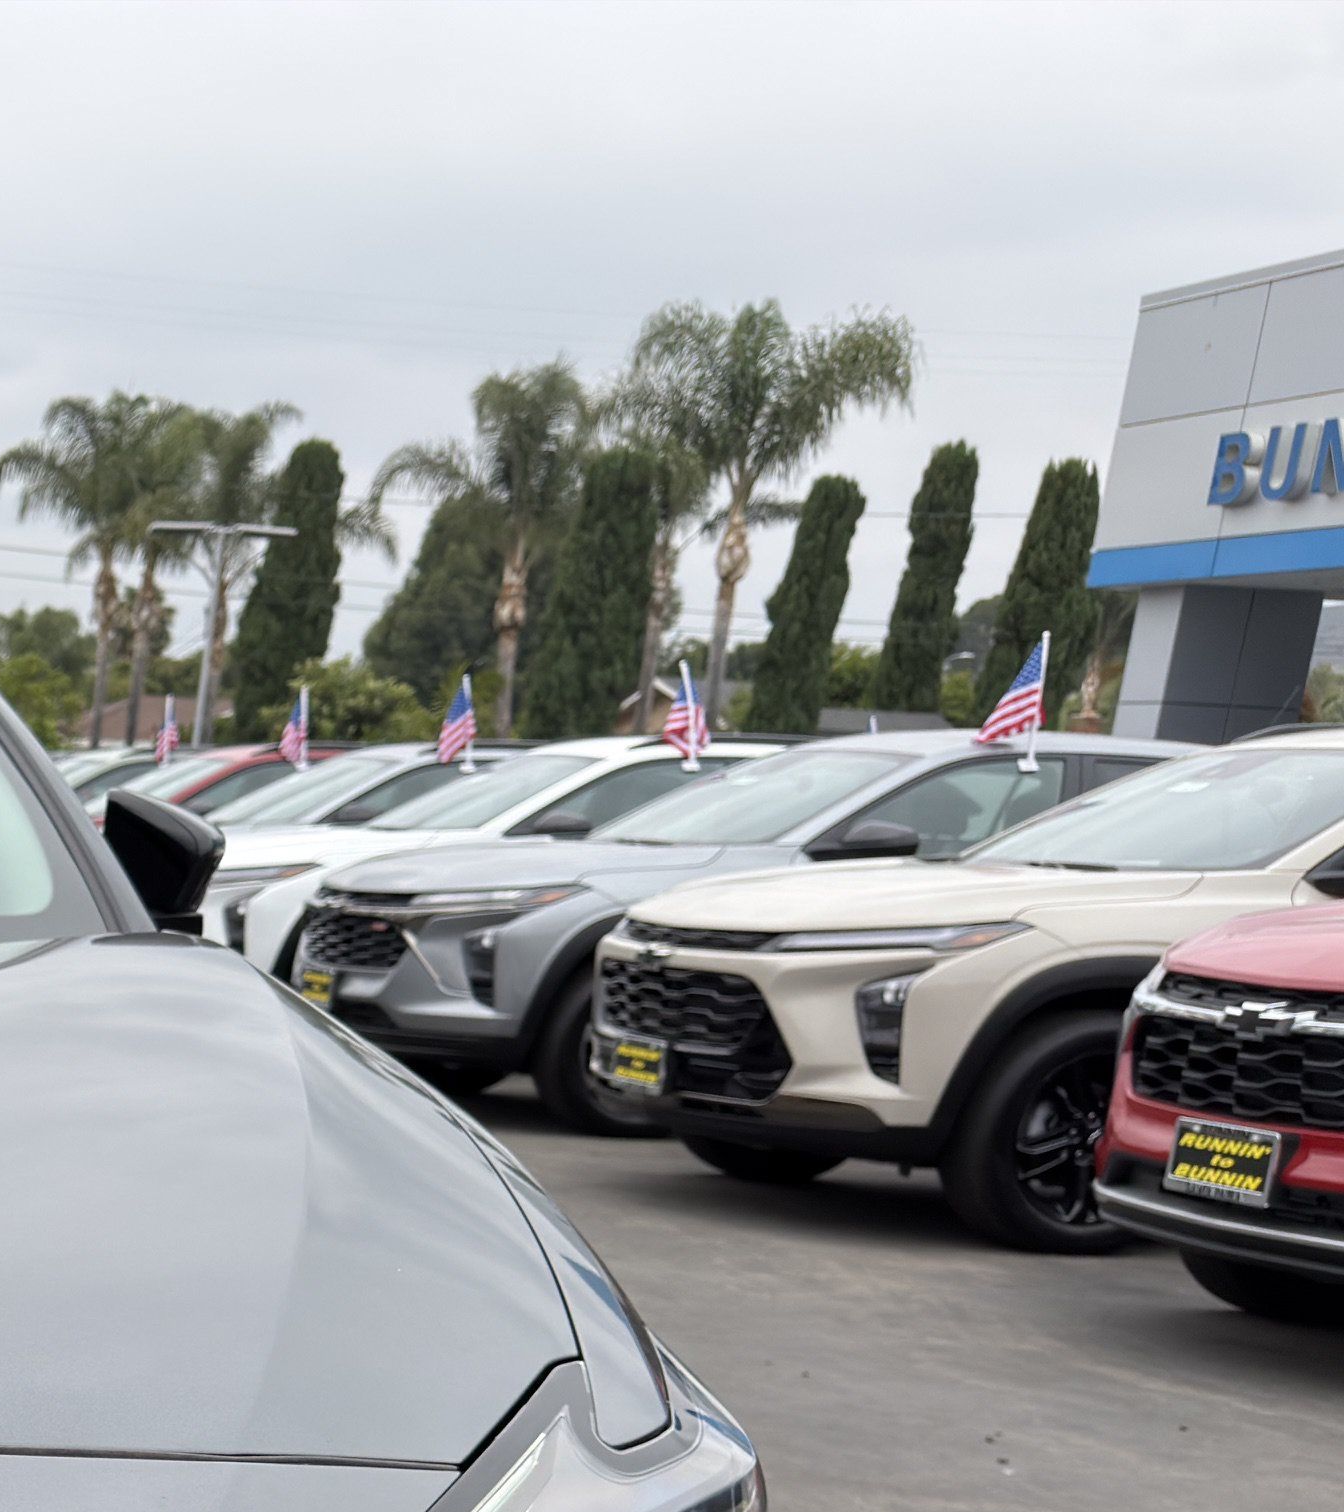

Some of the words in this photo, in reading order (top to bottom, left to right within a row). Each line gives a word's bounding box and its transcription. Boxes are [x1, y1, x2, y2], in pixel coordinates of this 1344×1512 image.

[1178, 1132, 1272, 1159] RUNNIN'
[1210, 1154, 1235, 1169] to
[1173, 1162, 1264, 1191] BUNNIN
